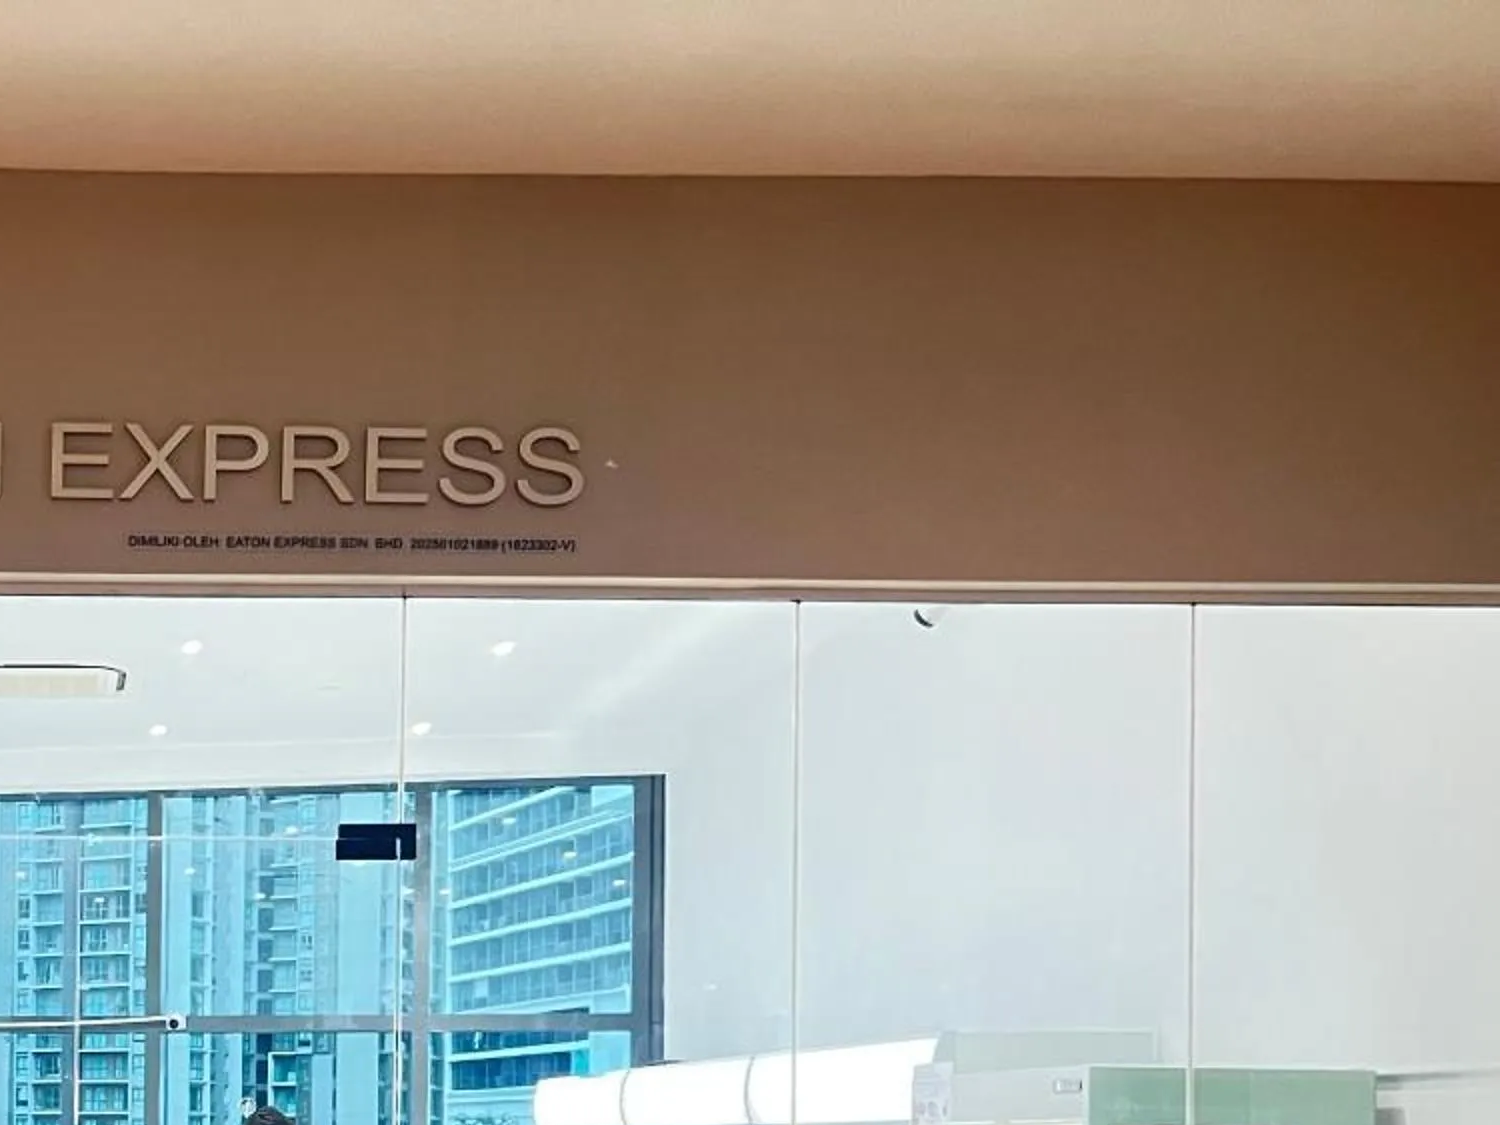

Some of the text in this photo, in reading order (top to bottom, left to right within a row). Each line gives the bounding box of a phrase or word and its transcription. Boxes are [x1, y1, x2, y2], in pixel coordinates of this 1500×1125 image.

[50, 421, 585, 505] EXPRESS
[127, 535, 179, 548] DIMILIKI
[183, 536, 219, 548] OLEH
[225, 536, 271, 549] EATON
[273, 537, 336, 549] EXPRESS
